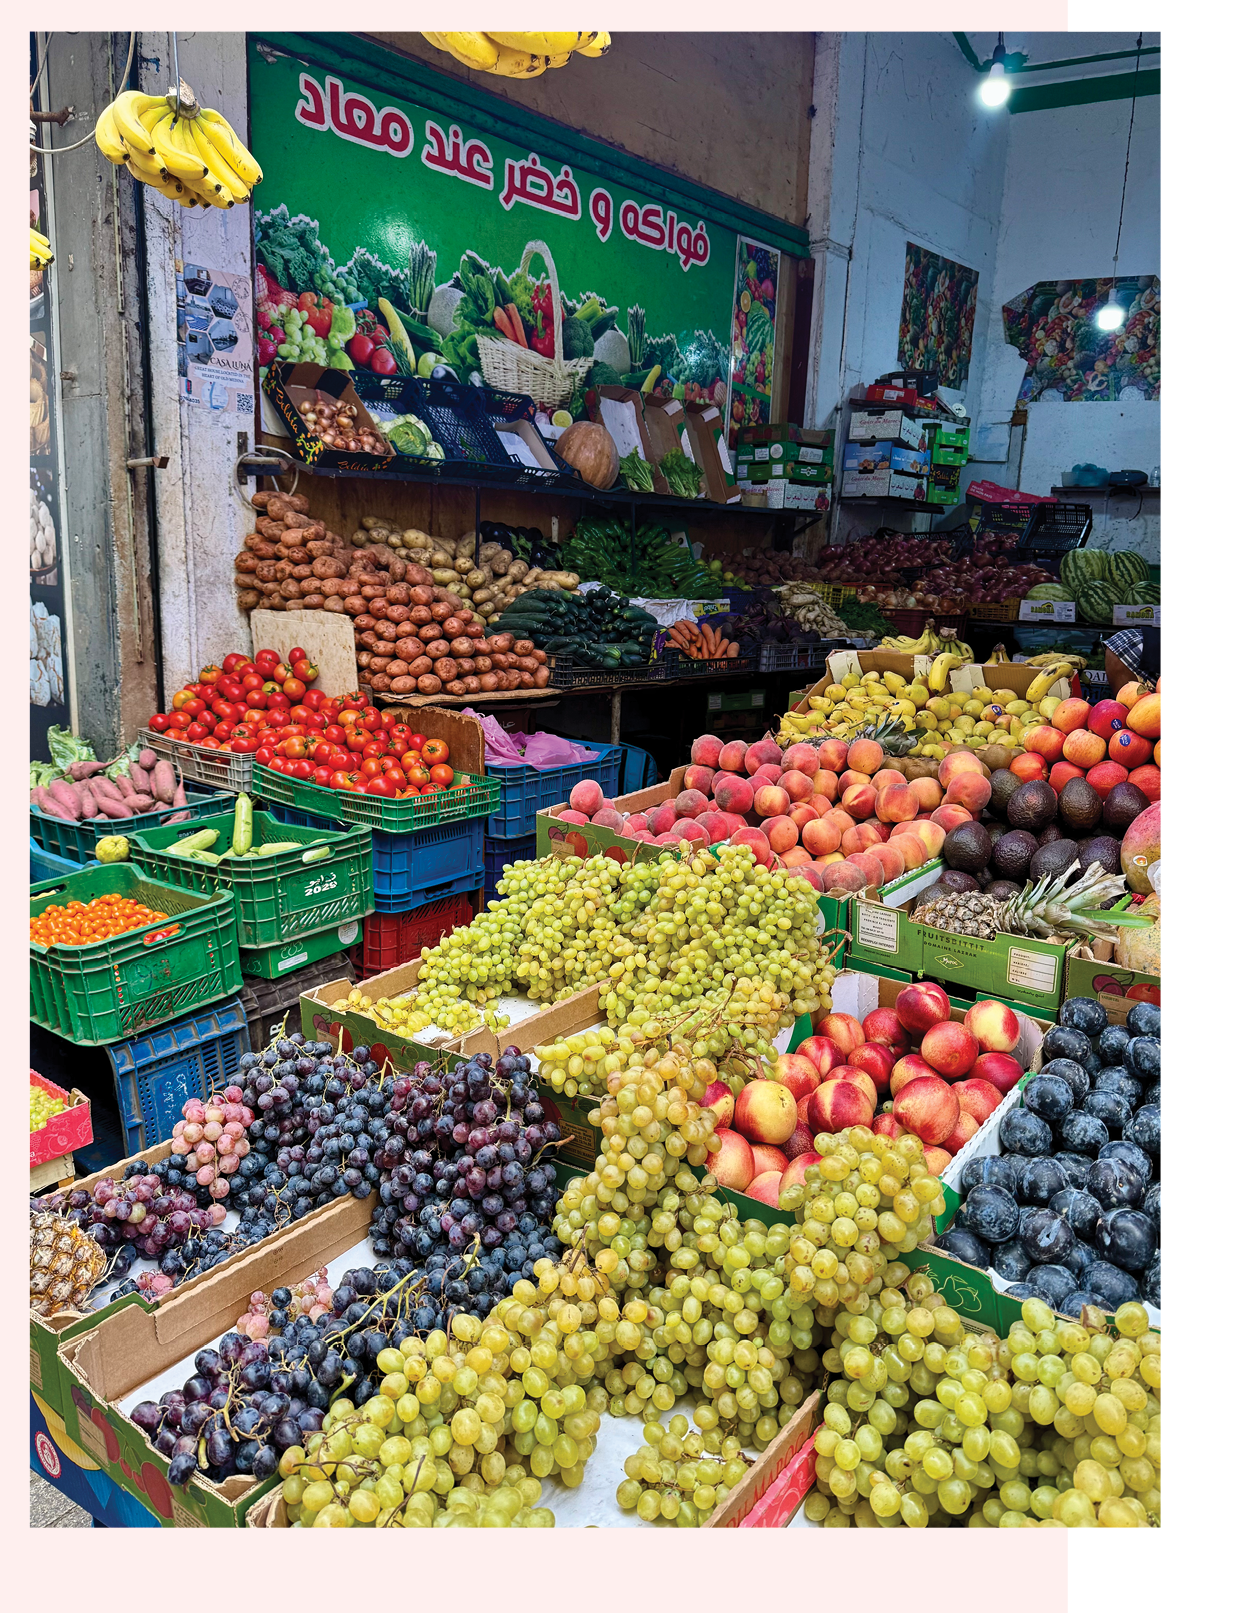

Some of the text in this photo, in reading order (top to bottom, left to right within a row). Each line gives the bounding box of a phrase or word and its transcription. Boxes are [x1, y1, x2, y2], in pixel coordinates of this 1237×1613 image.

[296, 75, 711, 268] فواكه و خضر عند معاد
[209, 357, 253, 372] CASA LUNA
[923, 941, 952, 953] DOMAINE
